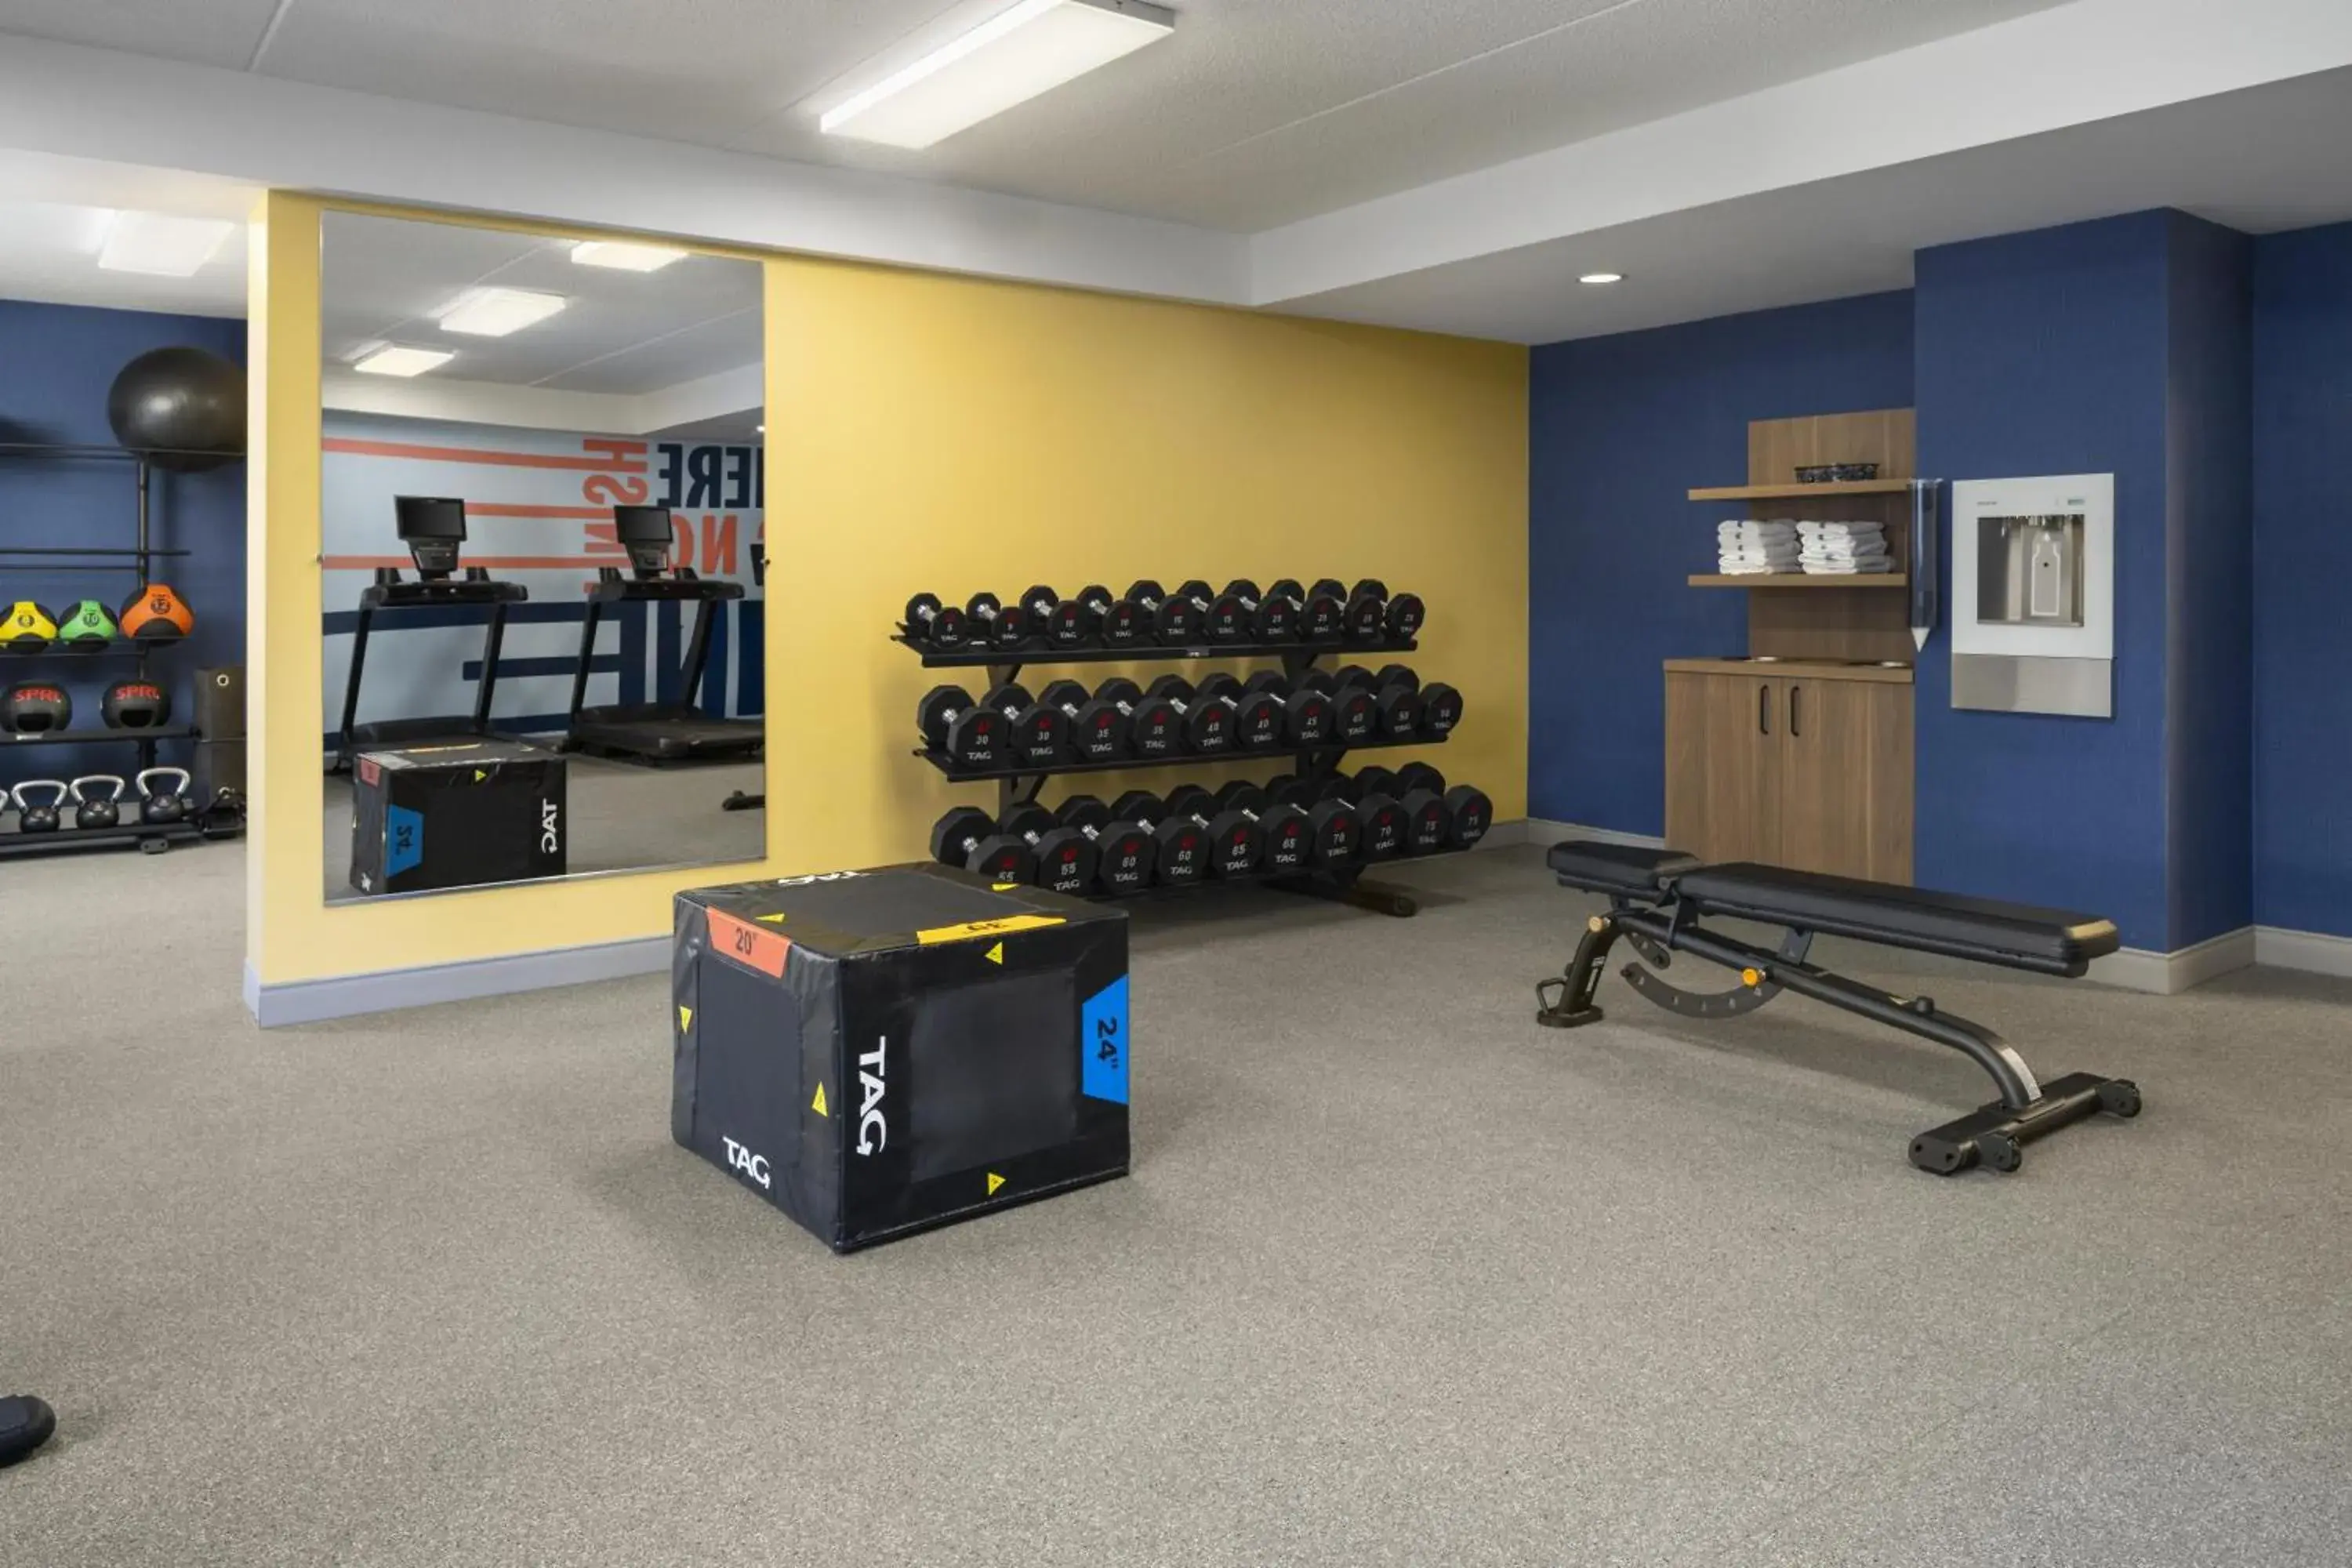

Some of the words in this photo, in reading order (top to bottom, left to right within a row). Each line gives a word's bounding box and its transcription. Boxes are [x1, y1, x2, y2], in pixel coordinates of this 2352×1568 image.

[1036, 731, 1051, 742] 30
[1250, 732, 1273, 743] TAG
[1300, 729, 1319, 740] TAG
[1145, 740, 1167, 750] TAG
[1203, 735, 1224, 747] TAG
[1029, 746, 1054, 757] TAG
[1091, 742, 1113, 753] TAG
[966, 750, 993, 760] TAG
[1374, 839, 1395, 851] TAG
[1327, 847, 1349, 858] TAG
[1275, 853, 1298, 864] TAG
[1225, 858, 1249, 872] TAG
[1170, 866, 1192, 876] TAG
[1114, 872, 1139, 882] TAG
[1053, 879, 1080, 891] TAG
[1098, 1016, 1119, 1069] 24"
[856, 1035, 886, 1157] TAG
[722, 1135, 771, 1190] TAG
